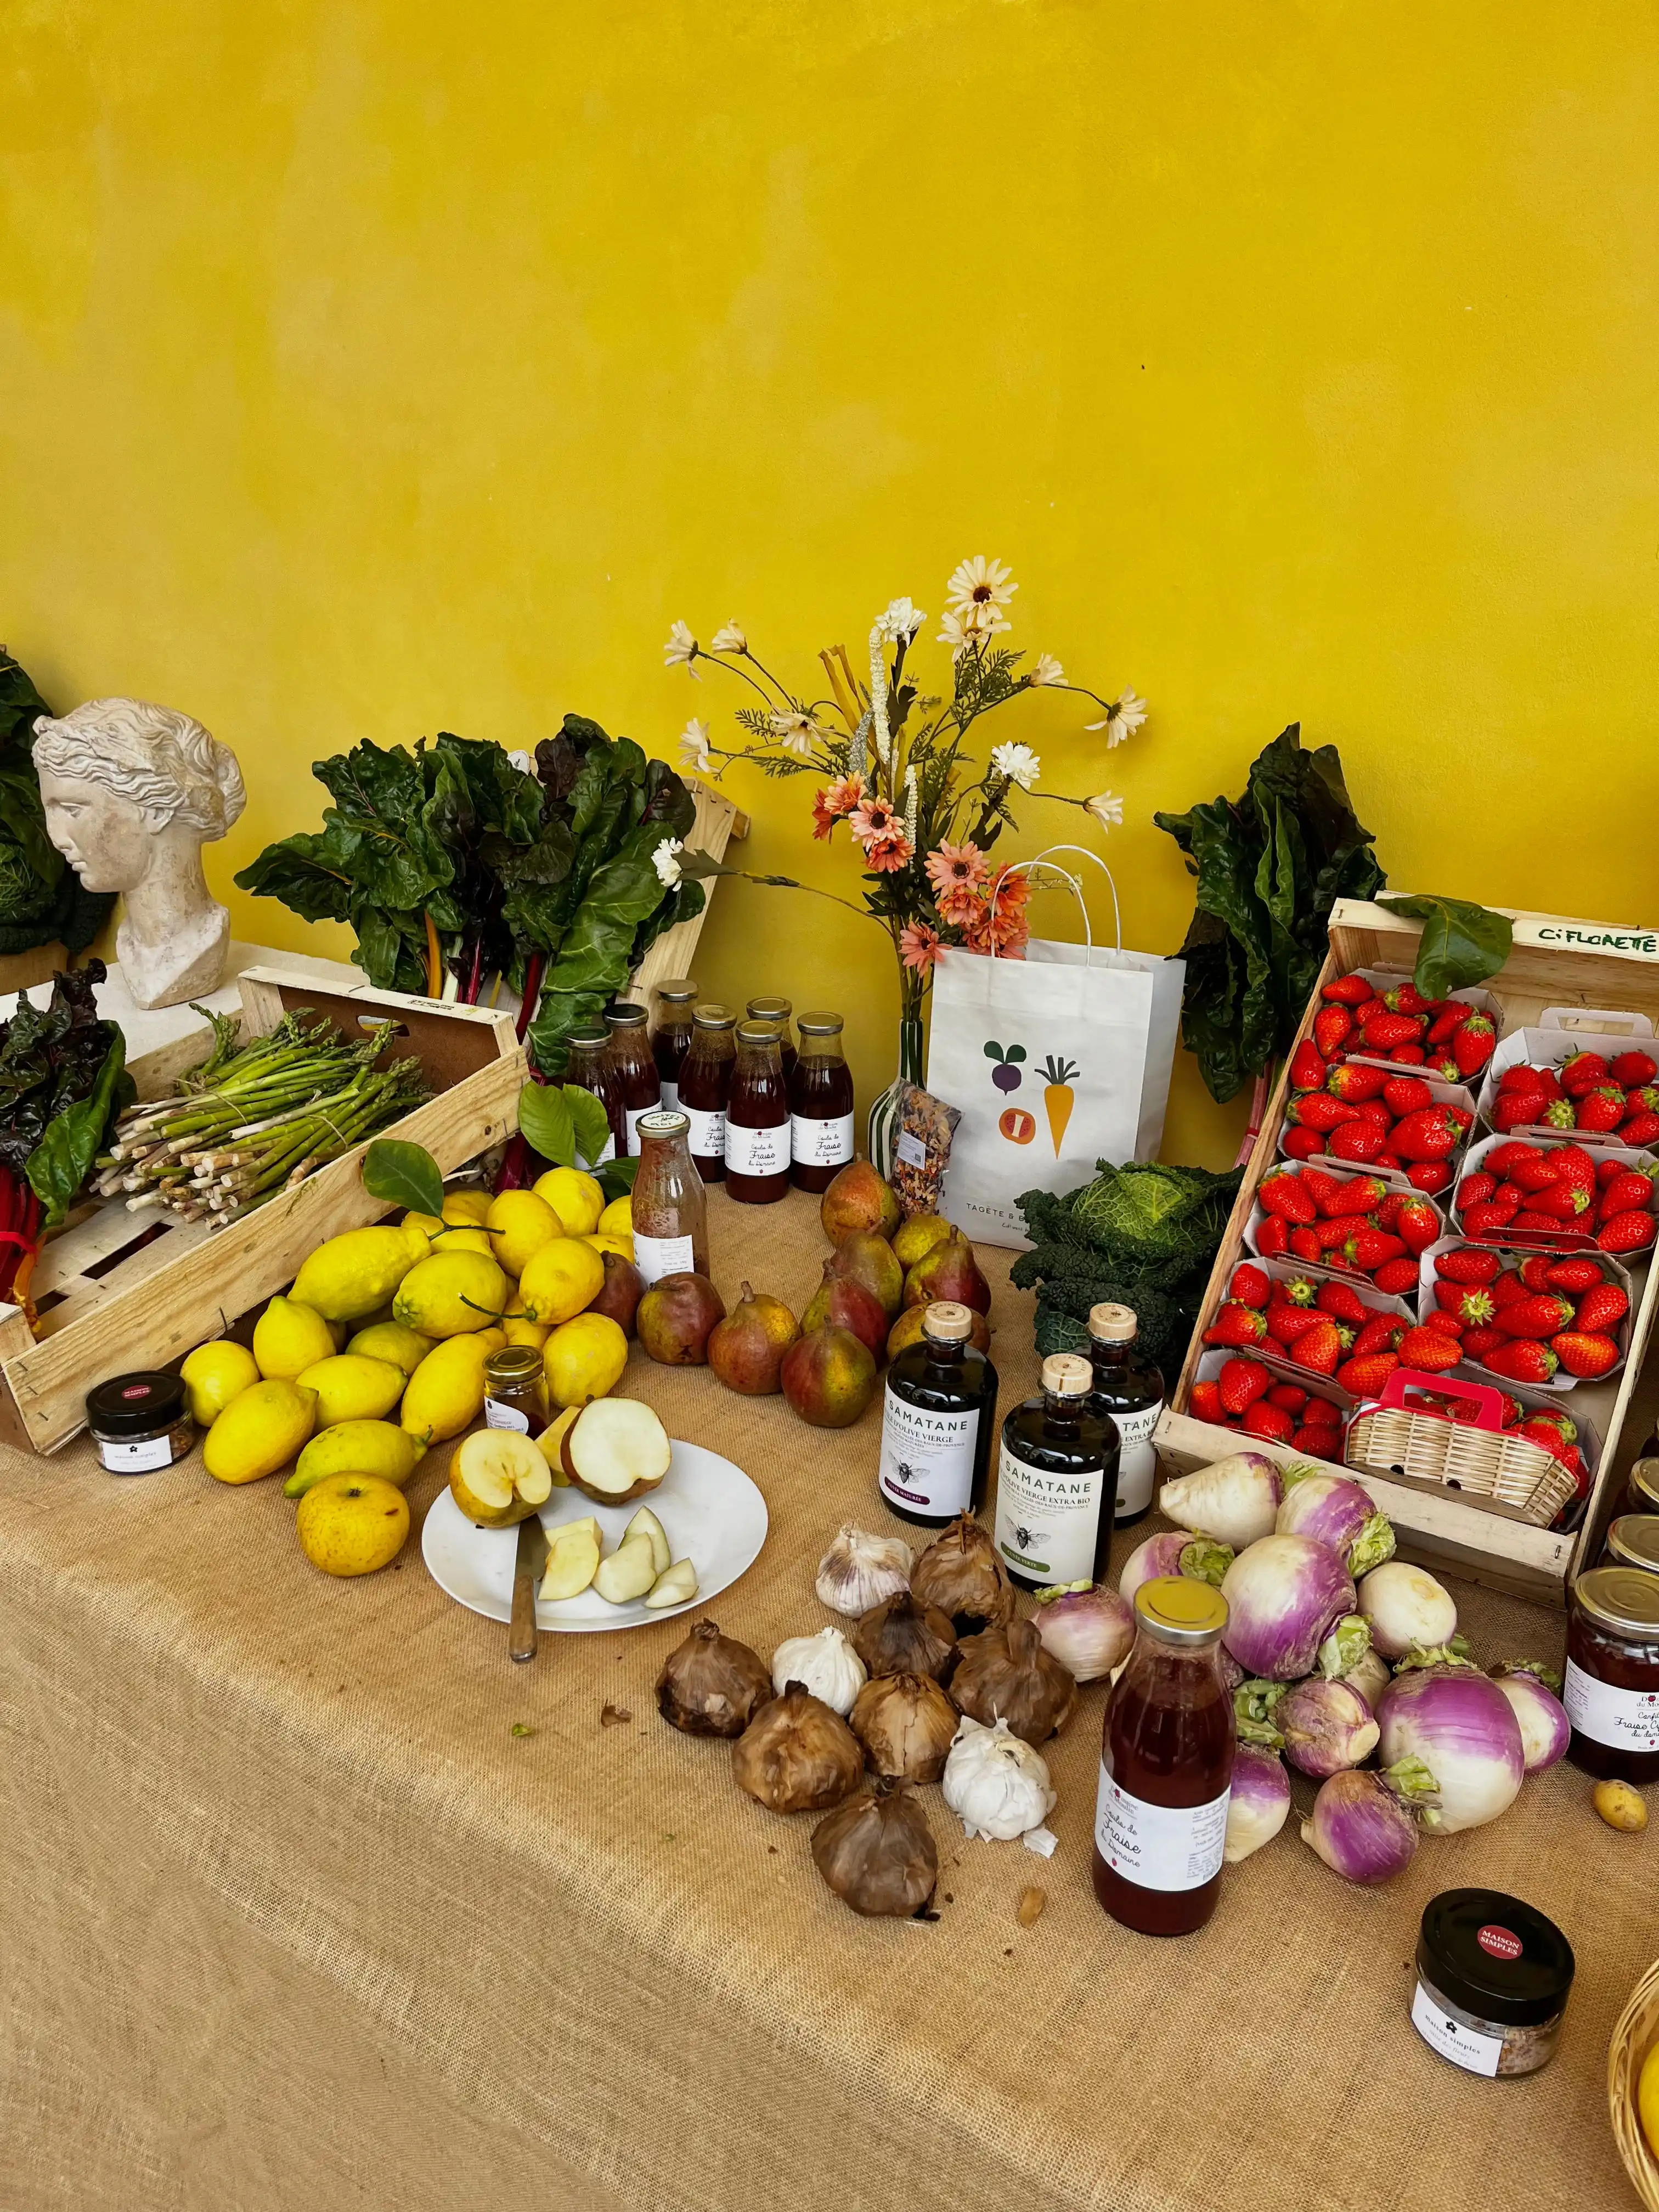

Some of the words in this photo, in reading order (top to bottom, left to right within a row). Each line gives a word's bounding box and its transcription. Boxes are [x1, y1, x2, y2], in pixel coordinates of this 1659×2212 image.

[749, 1150, 775, 1159] Fraise
[816, 1142, 842, 1150] Fraise
[966, 1203, 1005, 1217] TAGÈTE
[889, 1400, 968, 1431] SAMATANE
[1122, 1413, 1156, 1432] TANE
[922, 1433, 953, 1443] VIERGE
[1005, 1460, 1091, 1493] SAMATANE
[1022, 1487, 1047, 1502] VIERGE
[1613, 1717, 1647, 1730] Fraise
[1631, 1729, 1641, 1737] du
[1103, 1812, 1141, 1854] Fraise
[1127, 1824, 1138, 1836] de
[1108, 1838, 1141, 1867] Domaine
[1480, 1936, 1518, 1955] SIMPLES
[1482, 1930, 1520, 1949] MAISON
[1425, 2014, 1448, 2038] maison
[1449, 2035, 1481, 2055] simples
